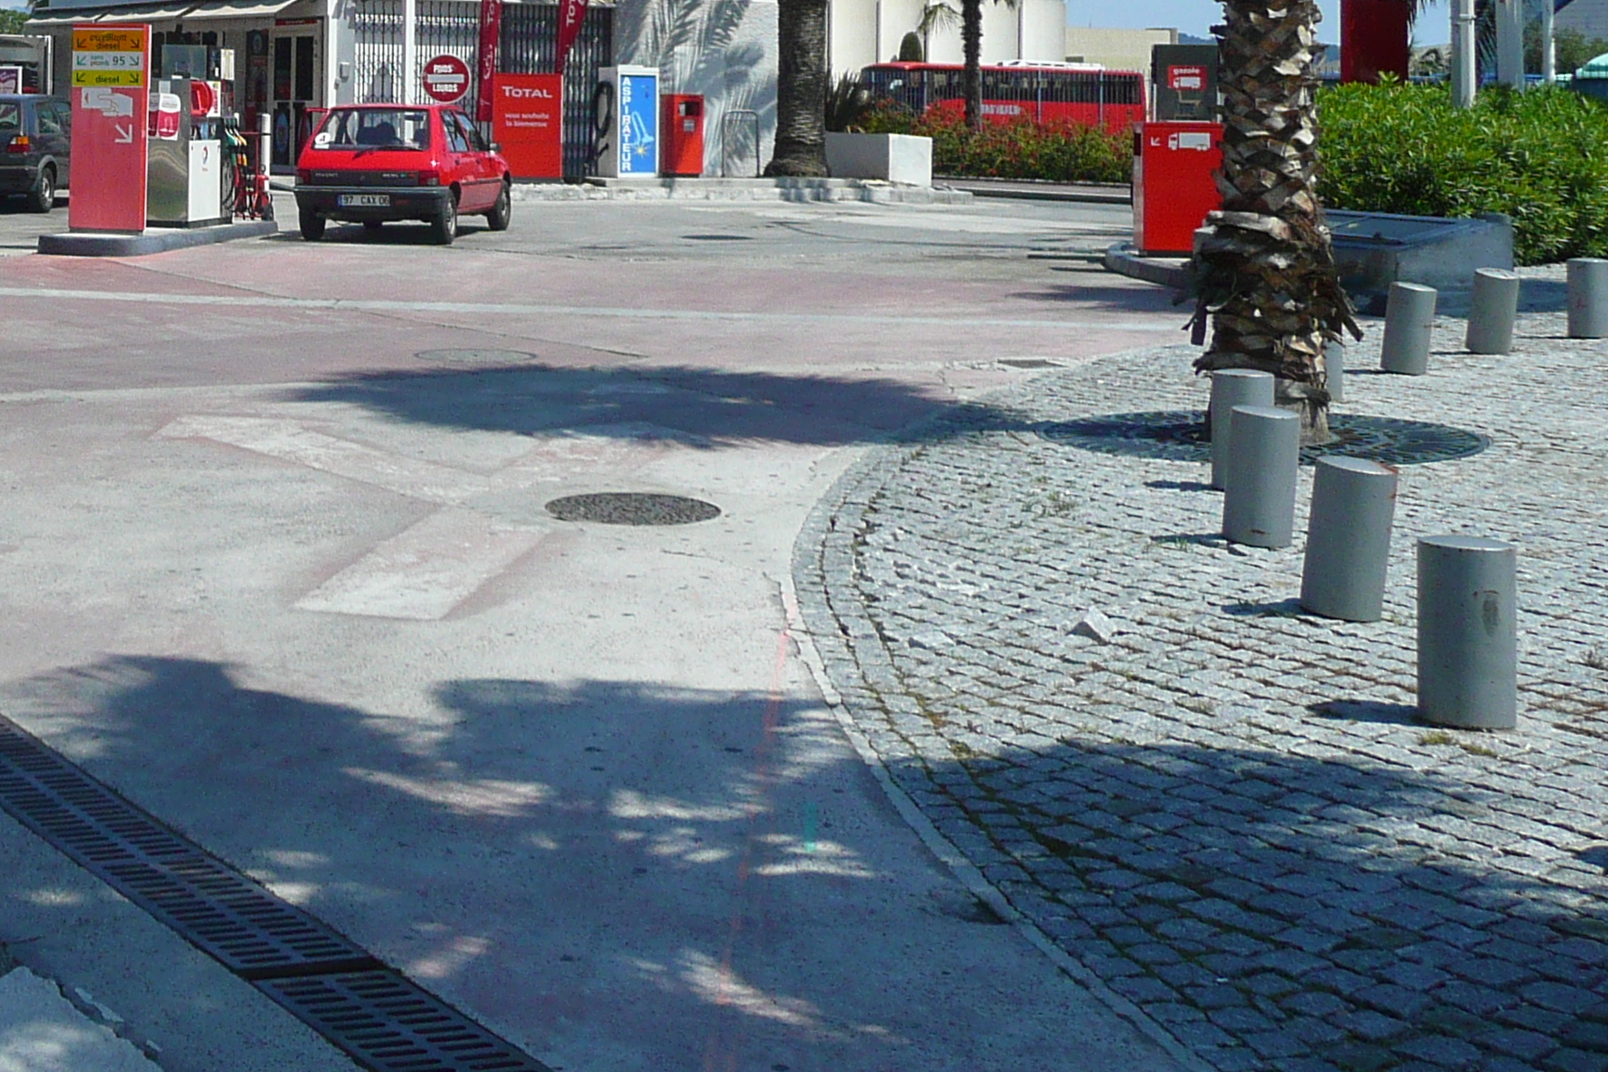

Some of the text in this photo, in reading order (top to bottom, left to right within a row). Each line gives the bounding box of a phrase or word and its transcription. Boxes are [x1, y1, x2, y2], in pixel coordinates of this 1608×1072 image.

[112, 55, 126, 67] 95
[95, 75, 120, 84] diesel
[501, 85, 553, 98] TOTAL
[622, 76, 632, 171] ASPIRATEUR
